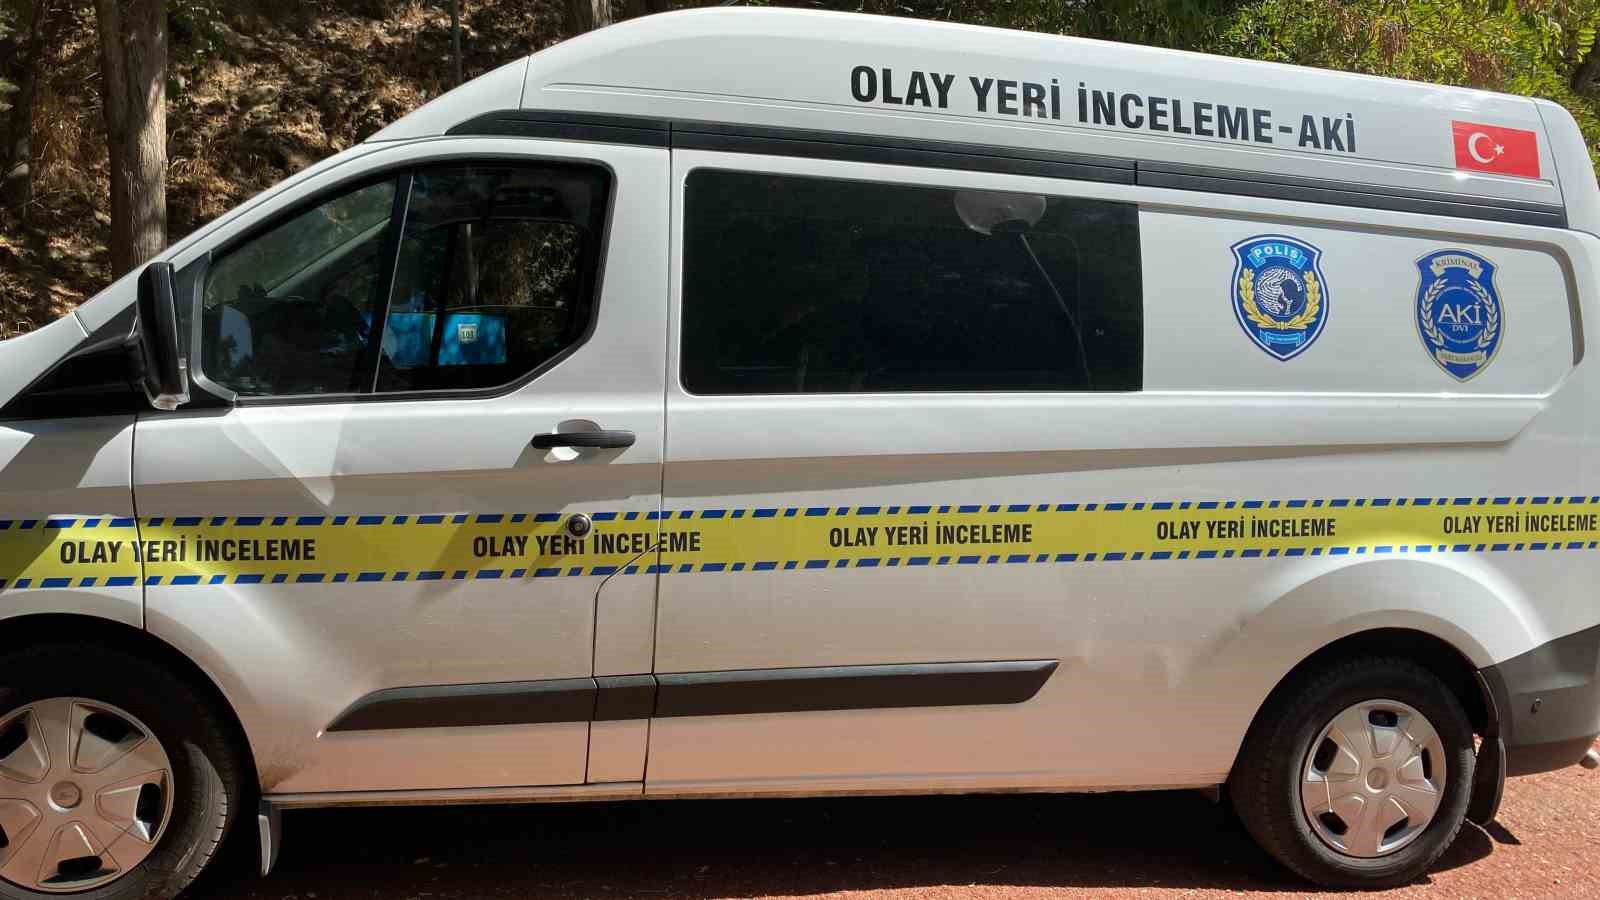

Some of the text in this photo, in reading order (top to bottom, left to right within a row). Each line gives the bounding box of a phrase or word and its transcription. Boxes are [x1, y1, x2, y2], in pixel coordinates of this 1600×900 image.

[850, 65, 1357, 153] OLAY YERİ İNCELEME-AKİ
[1439, 302, 1481, 324] AKİ
[829, 521, 1033, 547] OLAY YERİ İNCELEME
[1156, 515, 1336, 539] OLAY YERİ İNCELEME
[1443, 511, 1597, 533] OLAY YERİ İNCELEME
[60, 535, 316, 564] OLAY YERİ İNCELEME
[473, 535, 529, 558] OLAY
[593, 529, 701, 554] İNCELEME
